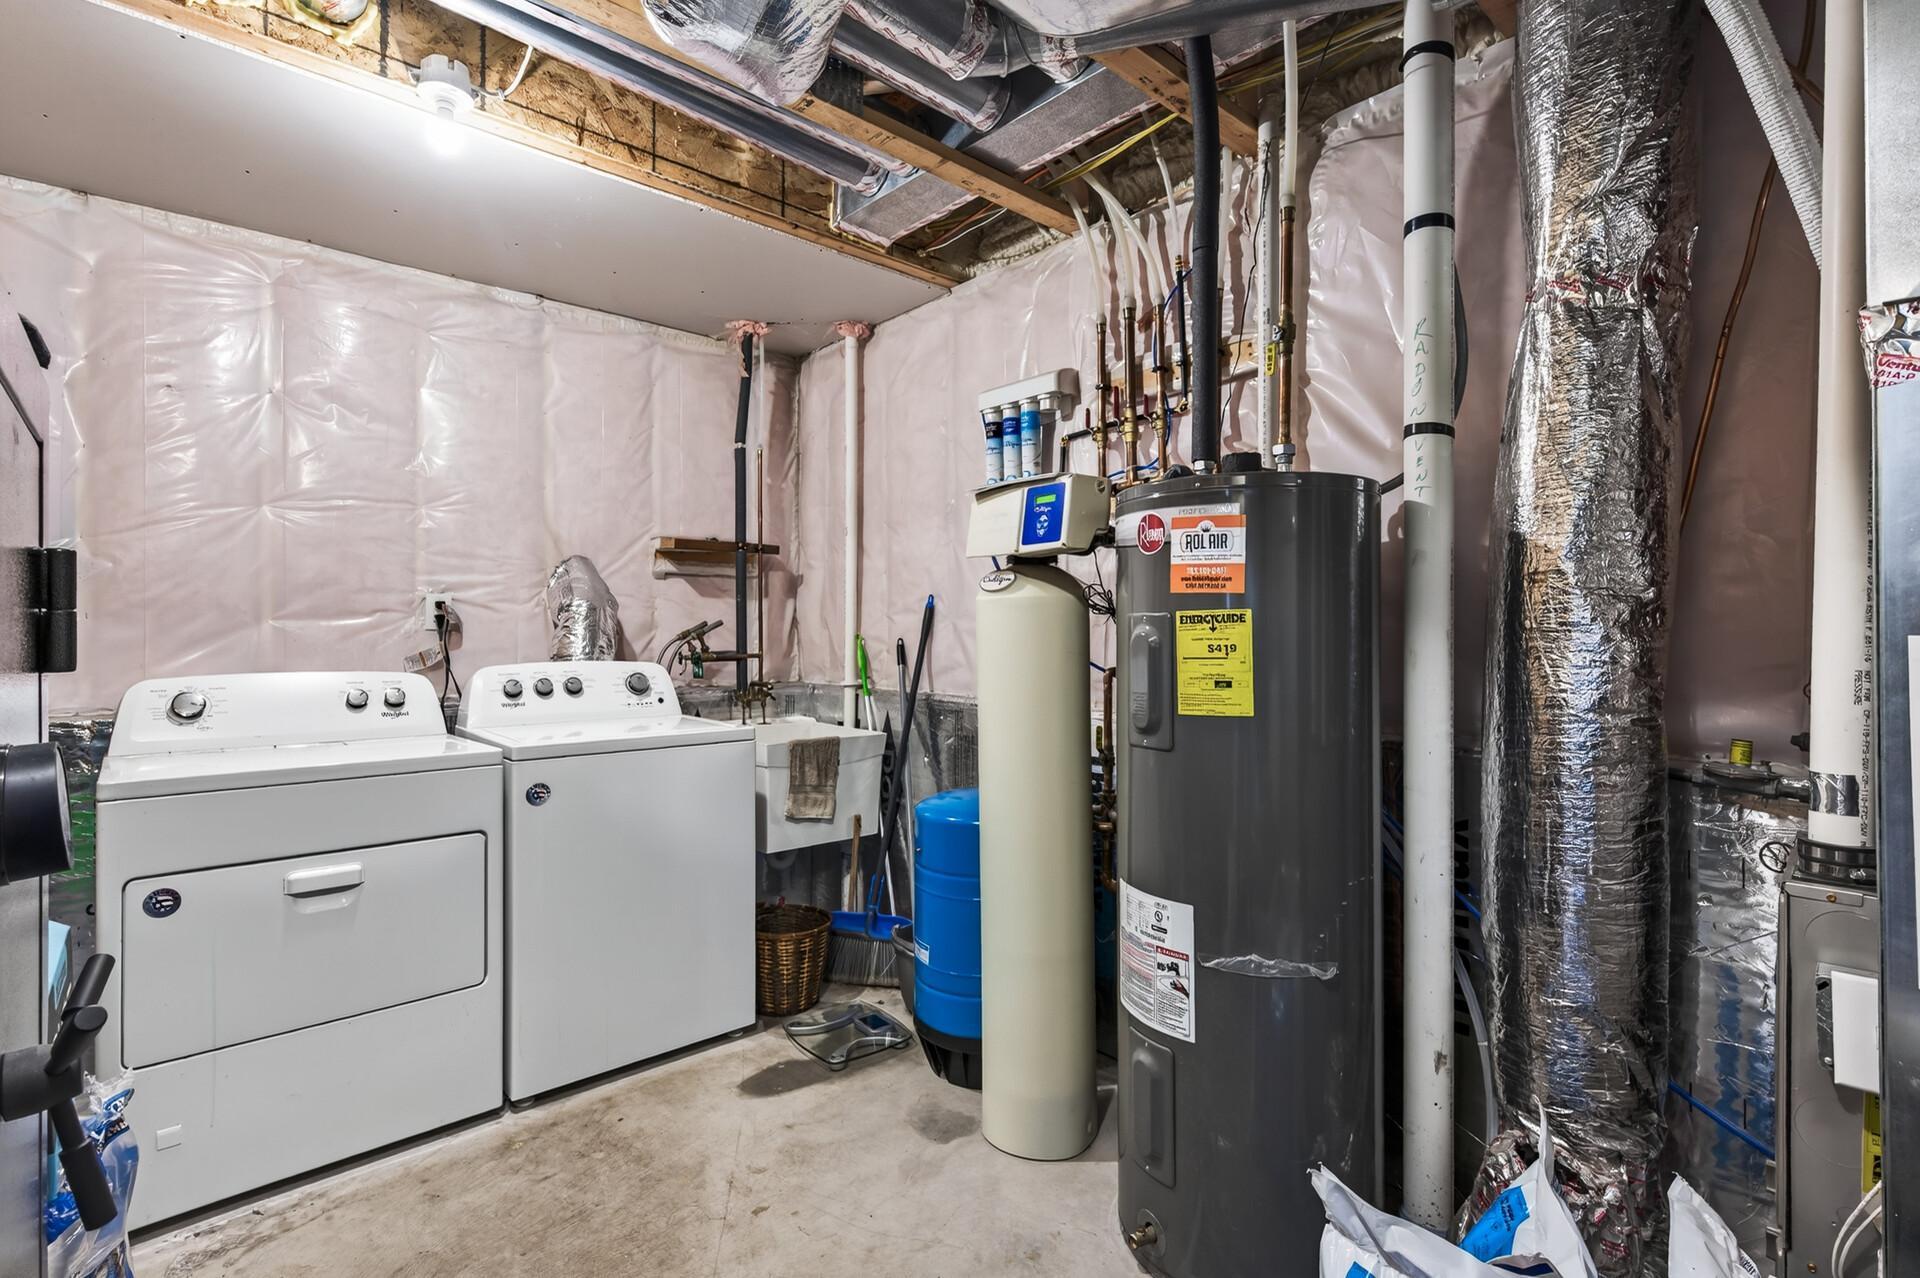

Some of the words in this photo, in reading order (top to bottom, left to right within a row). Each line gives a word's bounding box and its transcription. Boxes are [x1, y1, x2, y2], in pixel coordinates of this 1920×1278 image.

[1410, 317, 1433, 418] RADON
[1414, 436, 1432, 498] VENT
[1208, 533, 1228, 550] AIR
